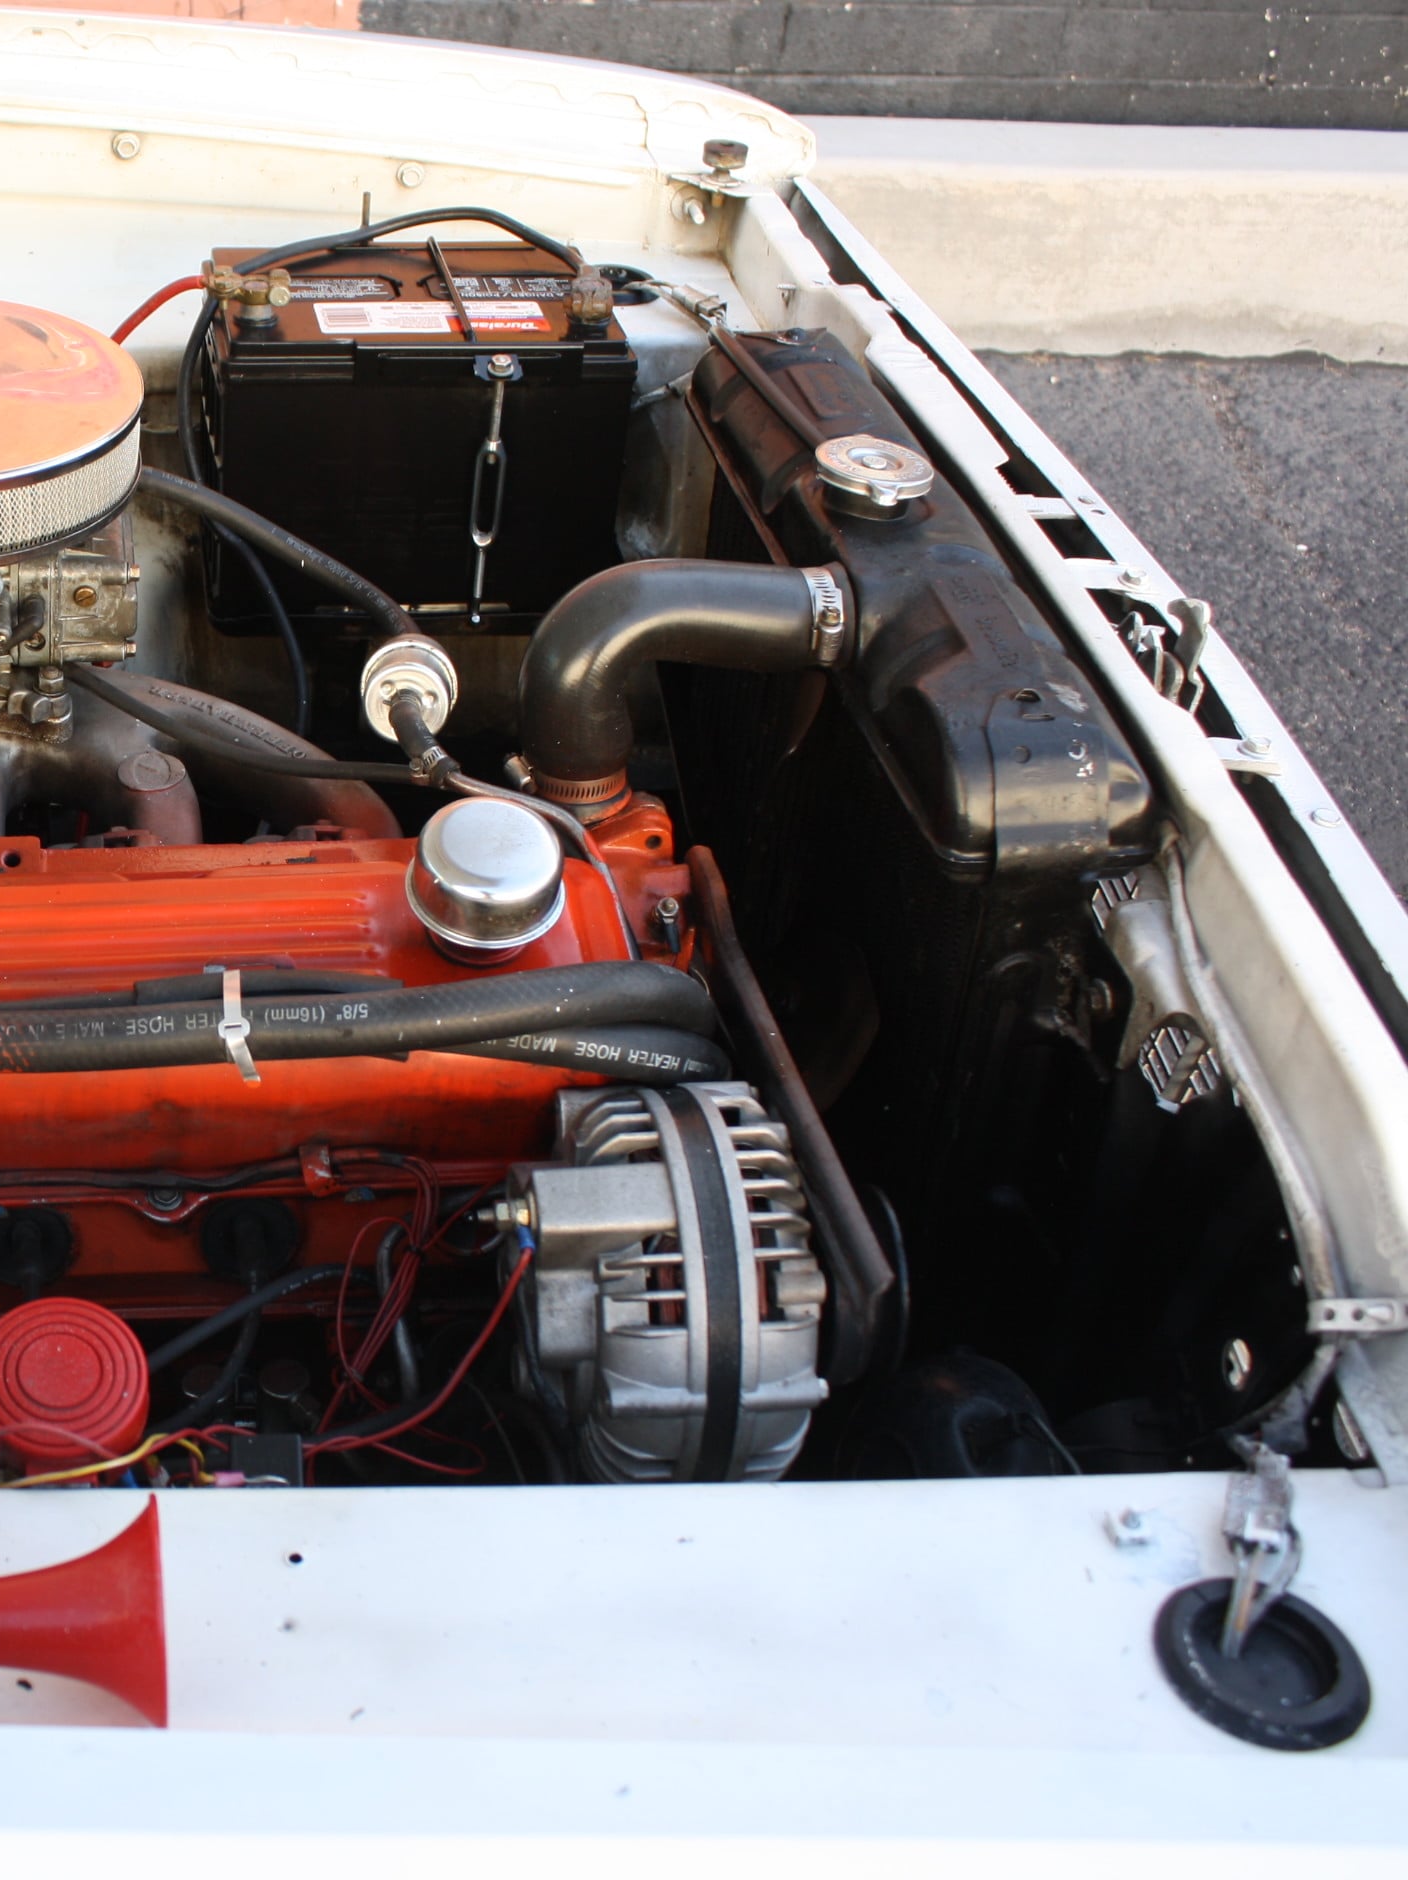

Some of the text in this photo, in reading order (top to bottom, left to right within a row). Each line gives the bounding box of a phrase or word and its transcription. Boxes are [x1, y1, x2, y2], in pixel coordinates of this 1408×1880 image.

[469, 321, 539, 330] Duralas
[263, 1006, 326, 1026] (16mm)
[336, 1003, 369, 1022] 5/8"
[125, 1015, 175, 1036] HOSE
[574, 1041, 622, 1062] HOSE
[628, 1048, 681, 1069] HEATER
